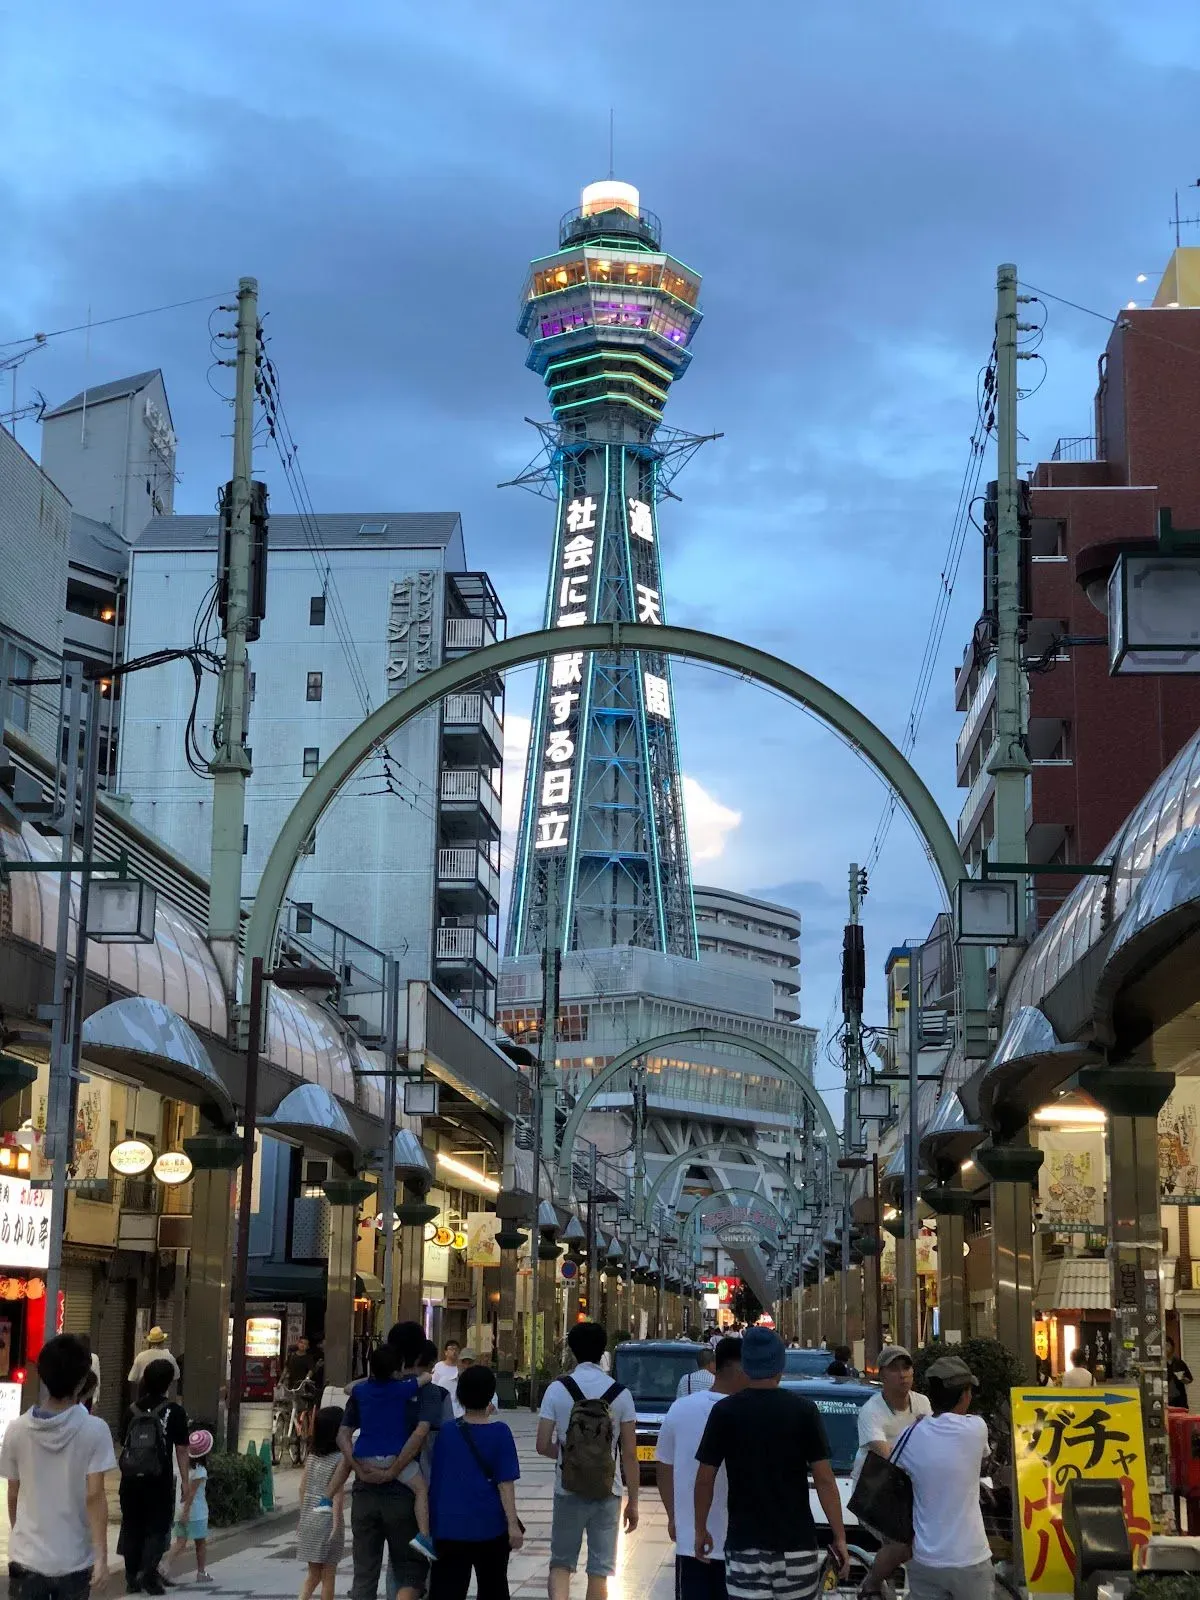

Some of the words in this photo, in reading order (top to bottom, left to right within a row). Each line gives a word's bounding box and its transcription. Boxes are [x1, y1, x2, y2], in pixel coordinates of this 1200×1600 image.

[628, 497, 672, 720] 通天閣
[534, 496, 597, 849] 社会に献する日立
[20, 1187, 45, 1207] ホルモン
[720, 1234, 760, 1242] SHINSEKAI
[1017, 1407, 1139, 1475] ガチャ
[1056, 1464, 1082, 1487] の
